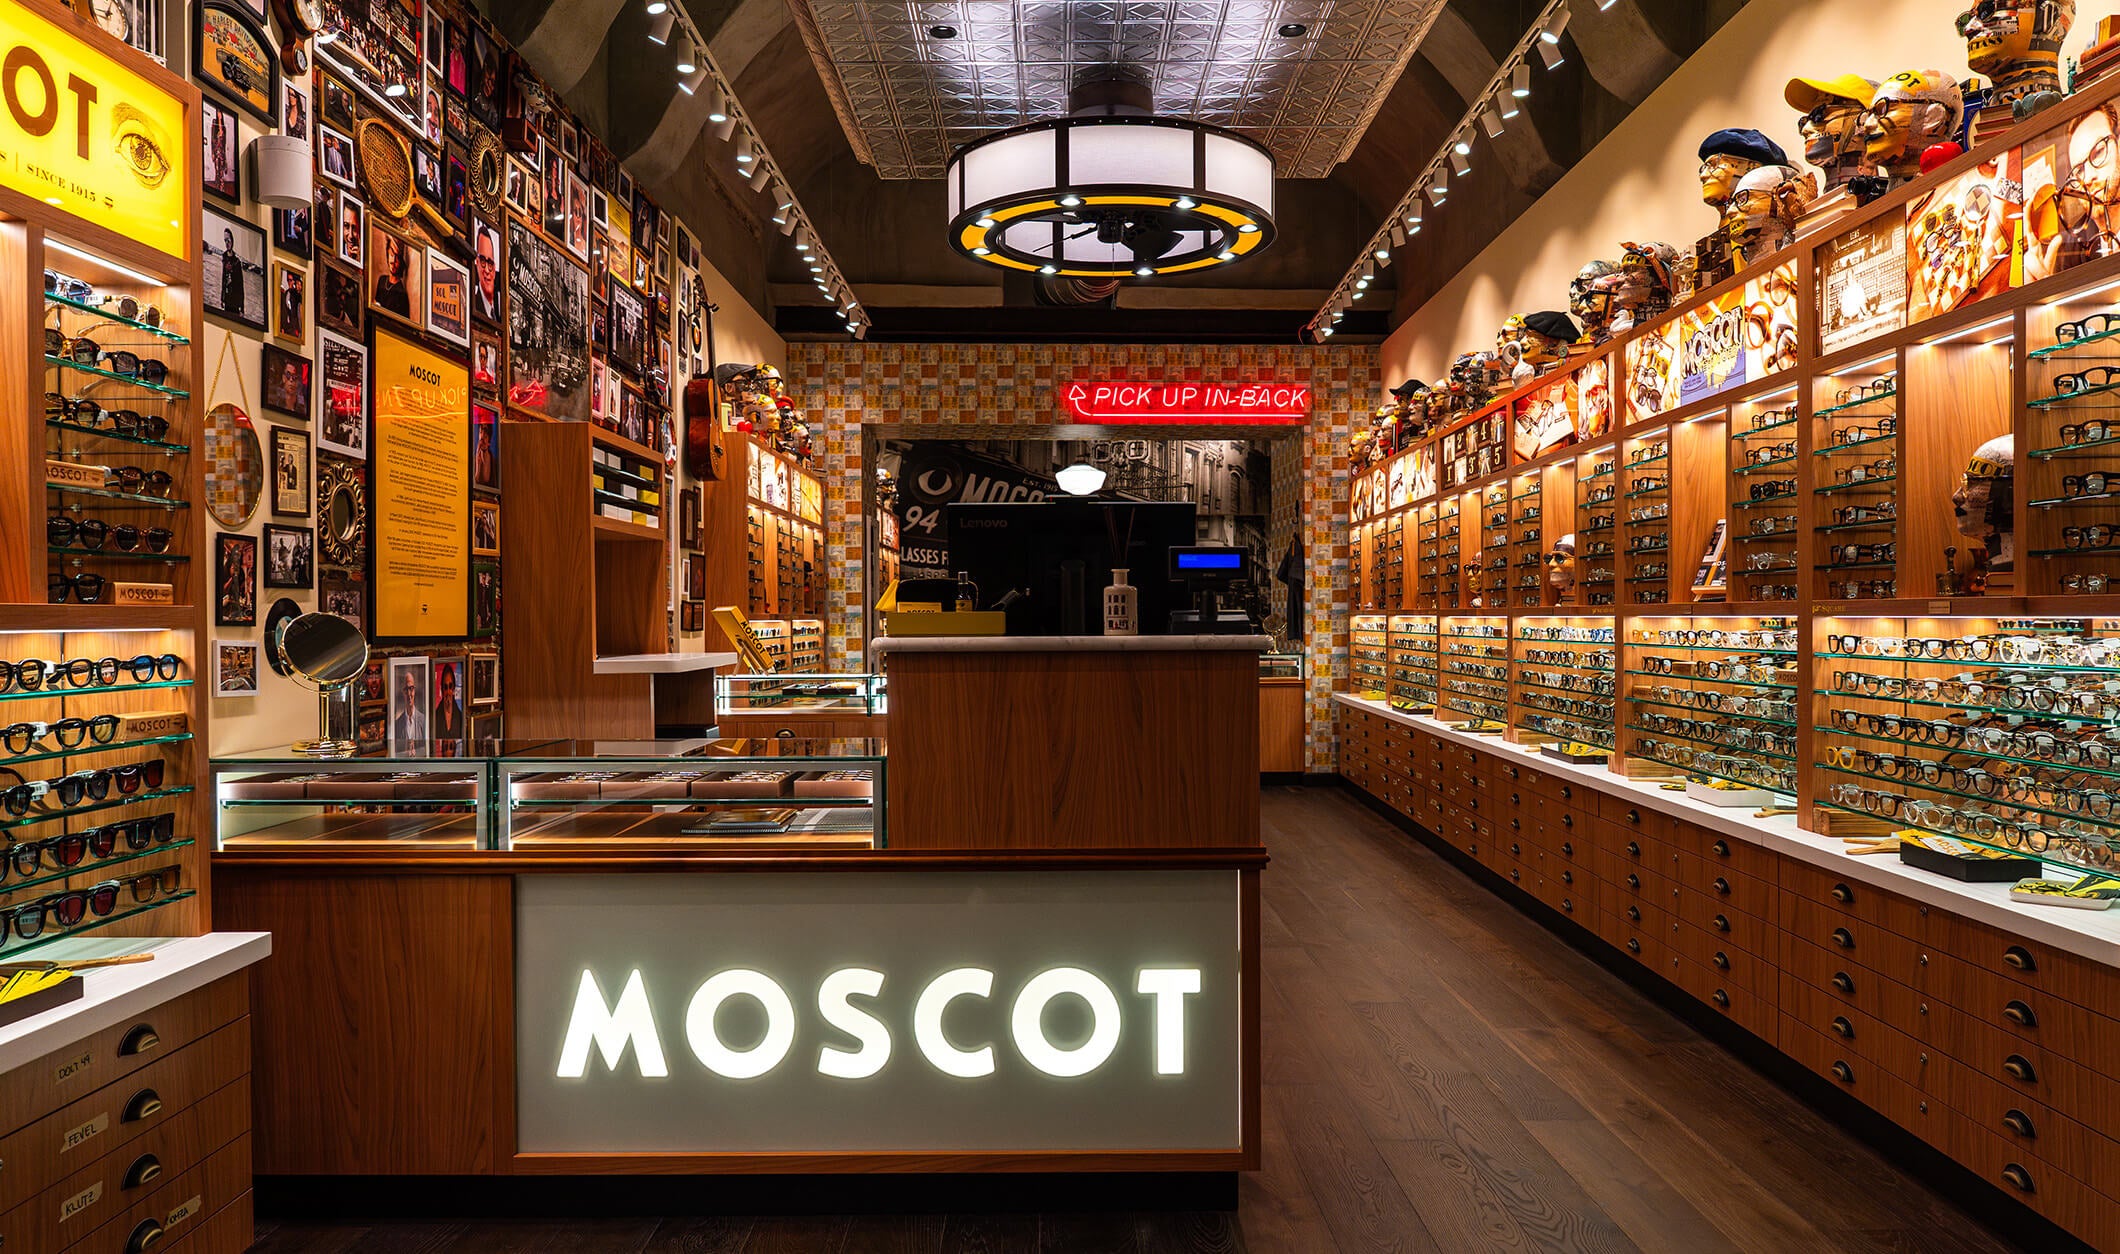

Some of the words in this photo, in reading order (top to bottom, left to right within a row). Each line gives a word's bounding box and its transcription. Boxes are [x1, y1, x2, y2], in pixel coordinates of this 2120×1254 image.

[27, 163, 66, 189] SINCE
[71, 182, 96, 203] 1915
[409, 364, 441, 387] MOSCOT
[1093, 387, 1152, 407] PICK
[1162, 387, 1198, 407] UP
[902, 506, 940, 534] 94
[959, 518, 1008, 529] Lenovo
[120, 588, 159, 600] MOSCOT
[740, 621, 766, 654] MOSCOT
[130, 719, 171, 733] MOSCOT
[556, 967, 1201, 1079] MOSCOT
[68, 1123, 97, 1147] FEVEL
[65, 1191, 95, 1216] KLUTZ
